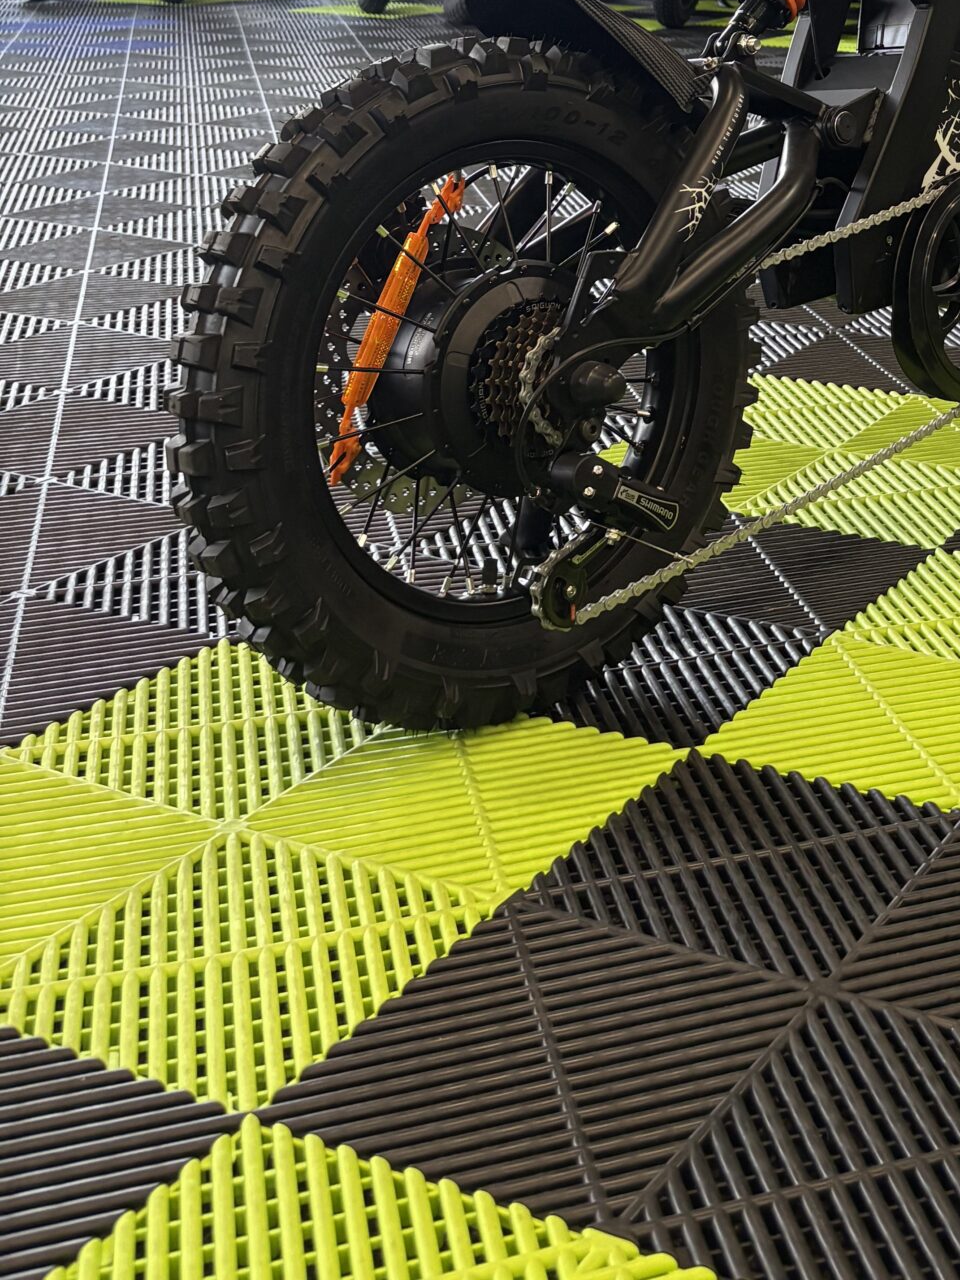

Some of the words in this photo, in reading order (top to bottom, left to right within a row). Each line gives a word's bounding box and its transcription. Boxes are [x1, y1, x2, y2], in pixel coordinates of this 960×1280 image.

[711, 145, 725, 165] RIDE
[722, 126, 733, 141] THE
[731, 94, 745, 124] FUTURE
[639, 497, 674, 520] SHIMANO
